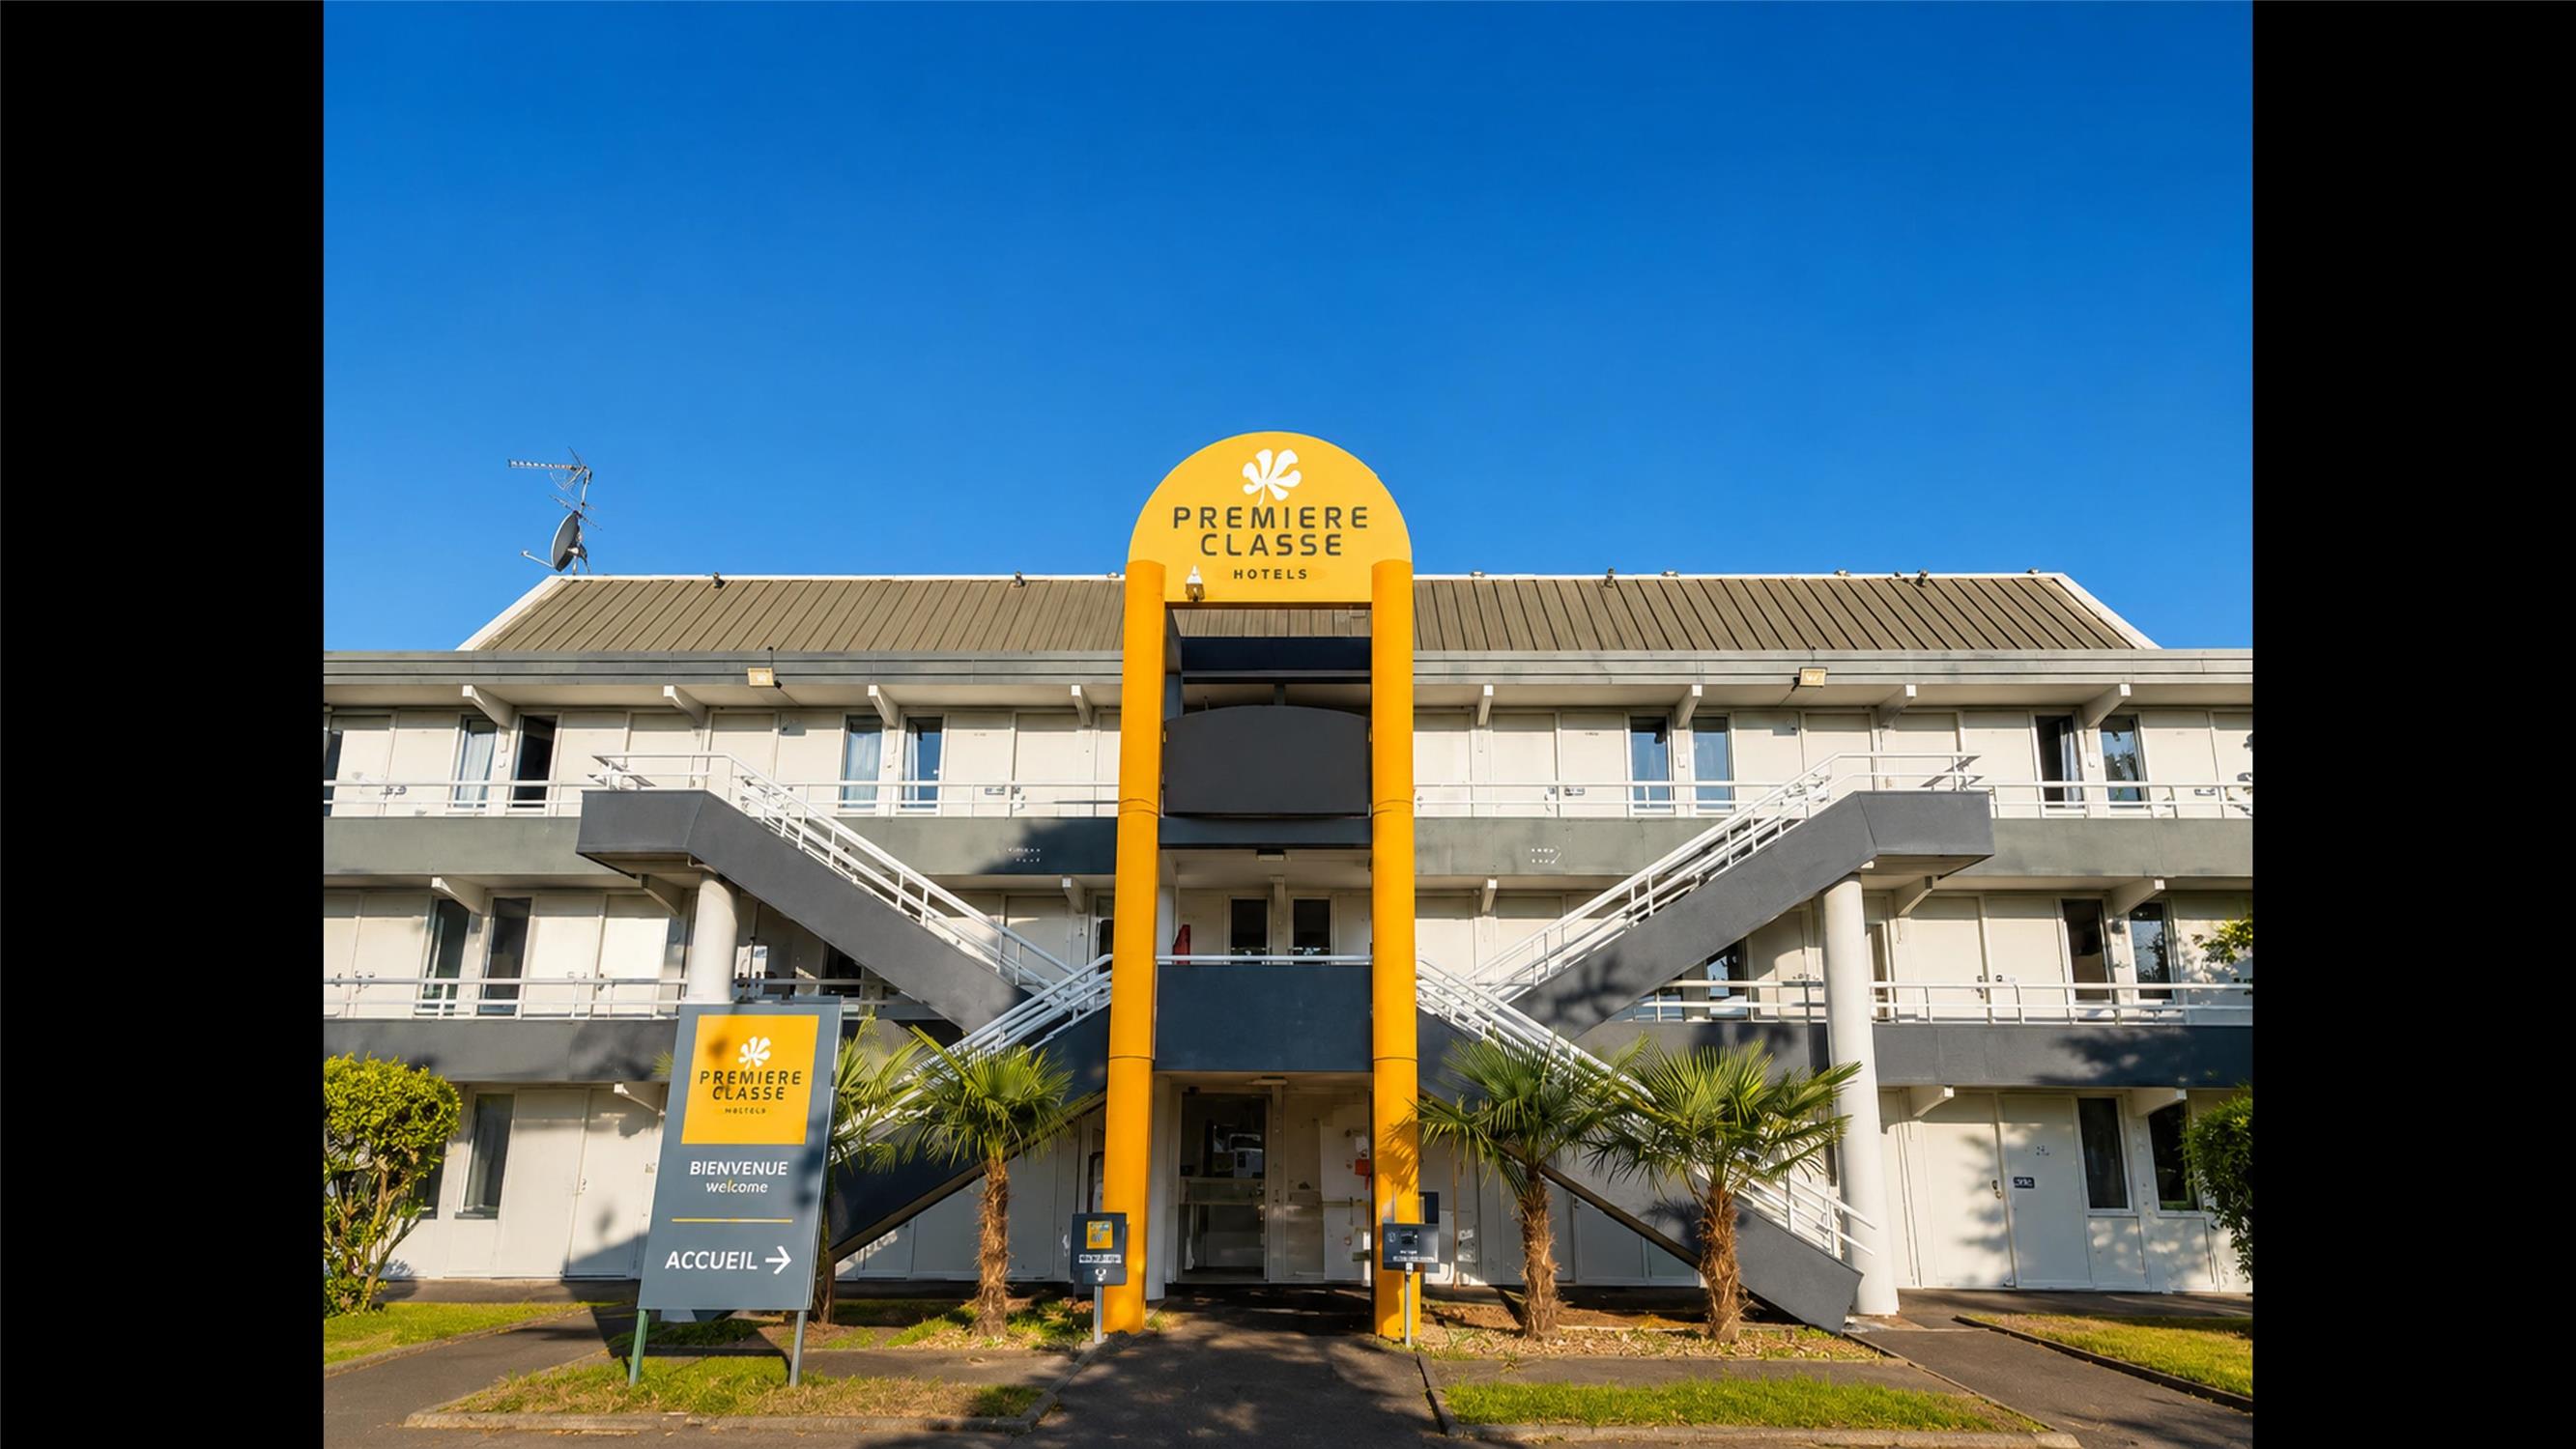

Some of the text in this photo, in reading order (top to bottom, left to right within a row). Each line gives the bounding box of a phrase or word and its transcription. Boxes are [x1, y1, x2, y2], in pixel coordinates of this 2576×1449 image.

[1173, 506, 1368, 529] PREMIERE
[1200, 533, 1342, 556] CLASSE
[1233, 569, 1307, 580] HOTELS
[699, 1069, 803, 1086] PREMIERE
[711, 1086, 786, 1101] CLASSE
[689, 1160, 788, 1177] BIENVENUE
[705, 1179, 769, 1194] welcome
[664, 1250, 758, 1270] ACCUEIL
